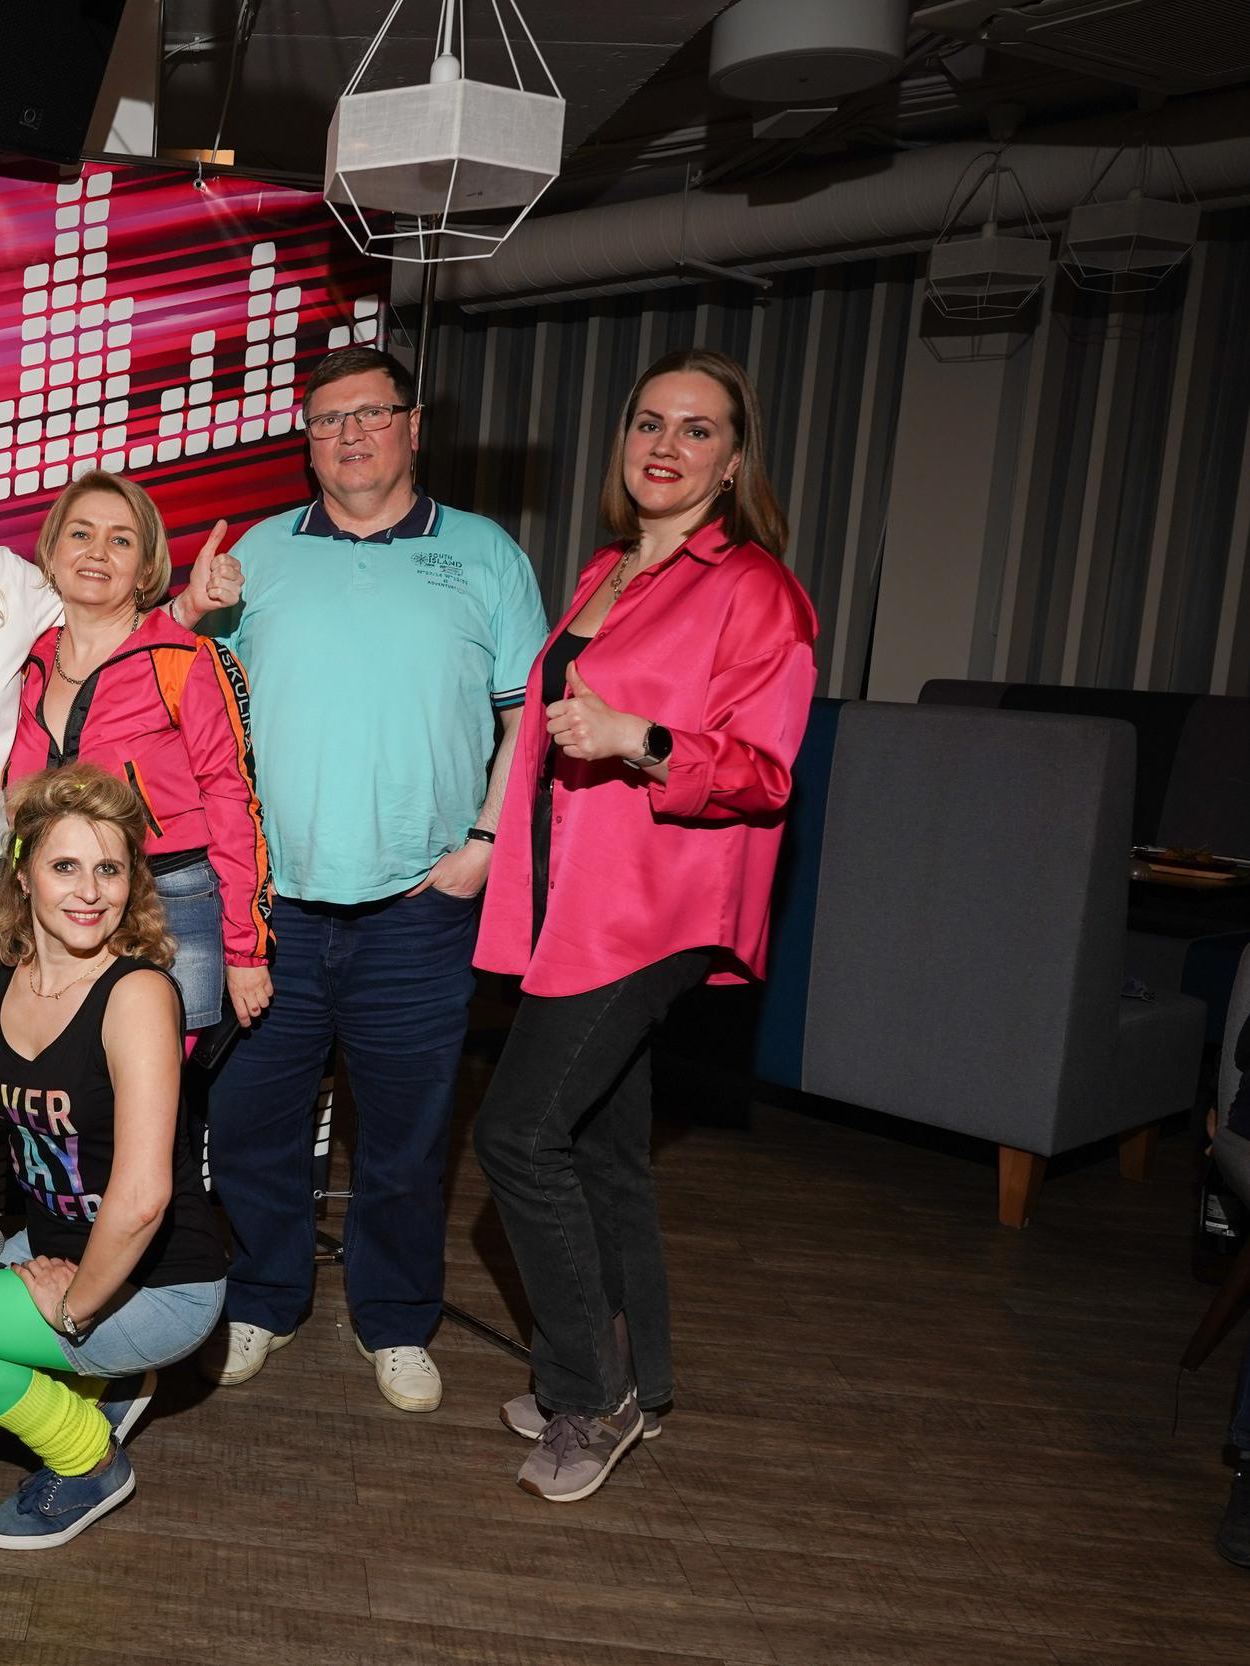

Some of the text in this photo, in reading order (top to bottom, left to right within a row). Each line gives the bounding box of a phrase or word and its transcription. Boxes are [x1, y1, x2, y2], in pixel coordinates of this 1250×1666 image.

[428, 552, 453, 561] SOUTH
[428, 557, 463, 568] ISLAND
[8, 1123, 84, 1194] AY
